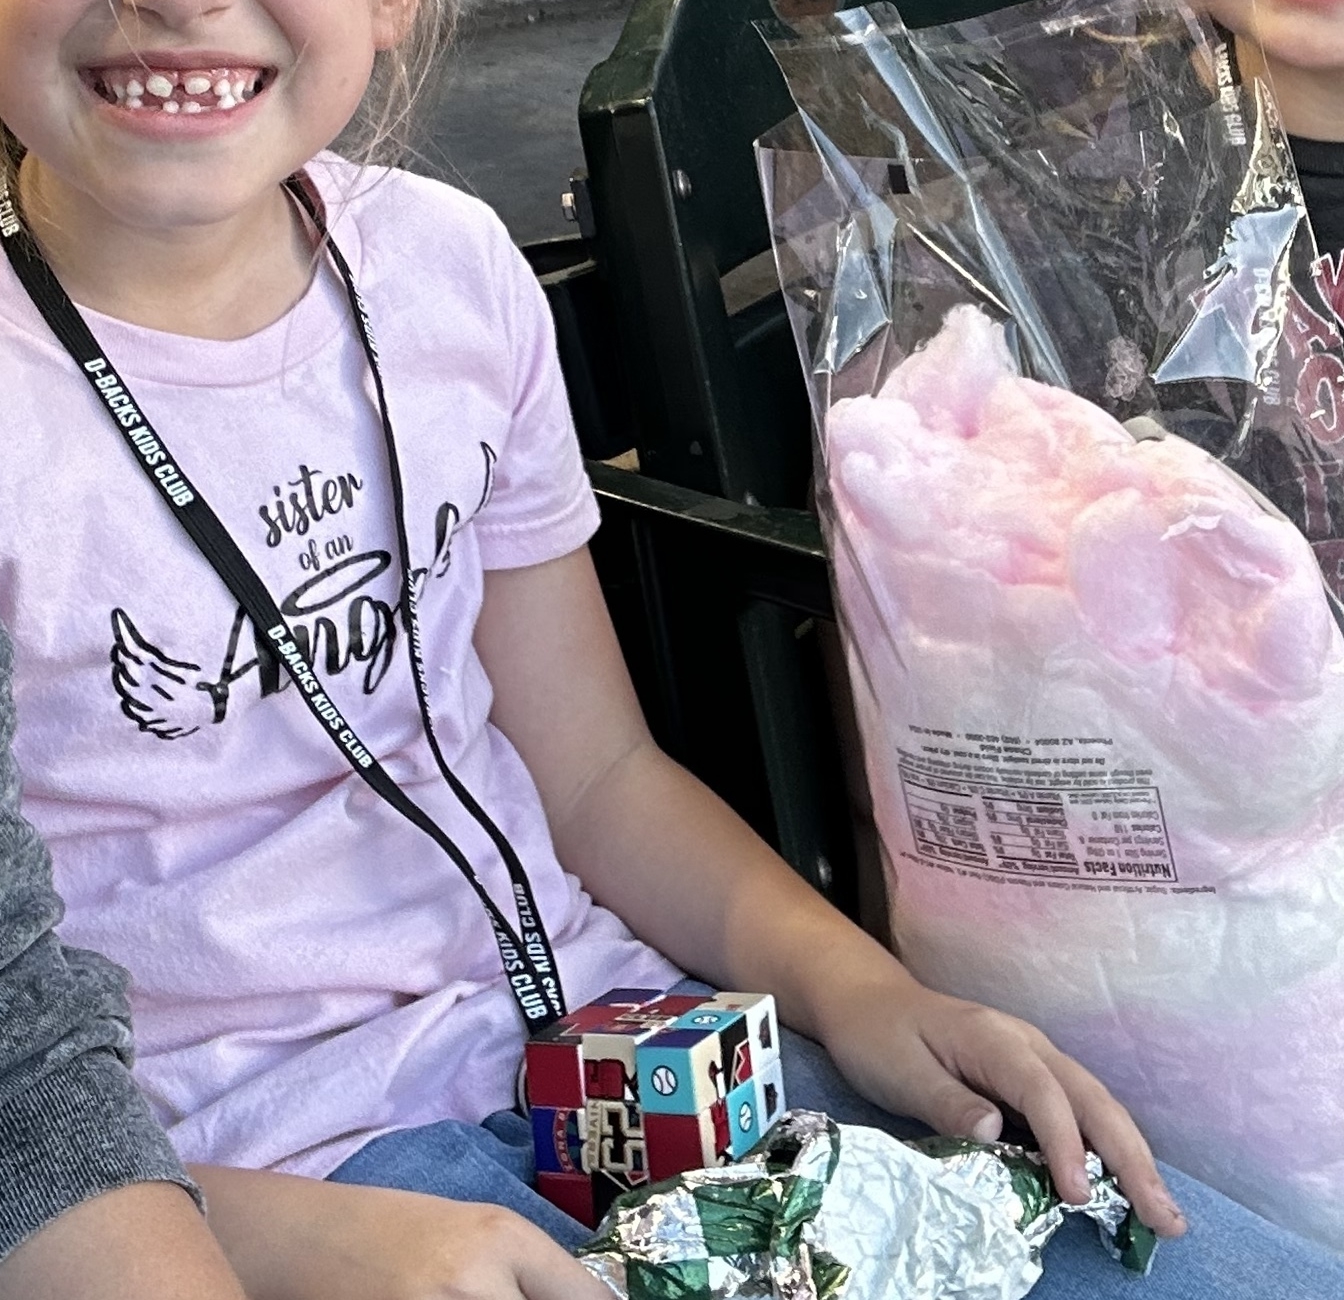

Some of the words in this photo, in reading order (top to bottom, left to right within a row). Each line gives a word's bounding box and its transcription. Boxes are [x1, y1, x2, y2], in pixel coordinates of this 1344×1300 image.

[84, 357, 142, 427] D-BACKS
[128, 425, 166, 465] KIDS
[154, 463, 195, 507] CLUB
[258, 464, 363, 548] sister
[298, 538, 320, 572] of
[324, 533, 354, 560] an
[267, 624, 320, 694] D-BACKS
[310, 692, 345, 730] KIDS
[339, 729, 374, 769] CLUB
[1083, 861, 1117, 876] Facts
[1117, 862, 1172, 878] Nutrition
[512, 883, 537, 928] CLUB
[525, 931, 552, 973] KIDS
[495, 930, 525, 972] KIDS
[511, 973, 549, 1020] CLUB
